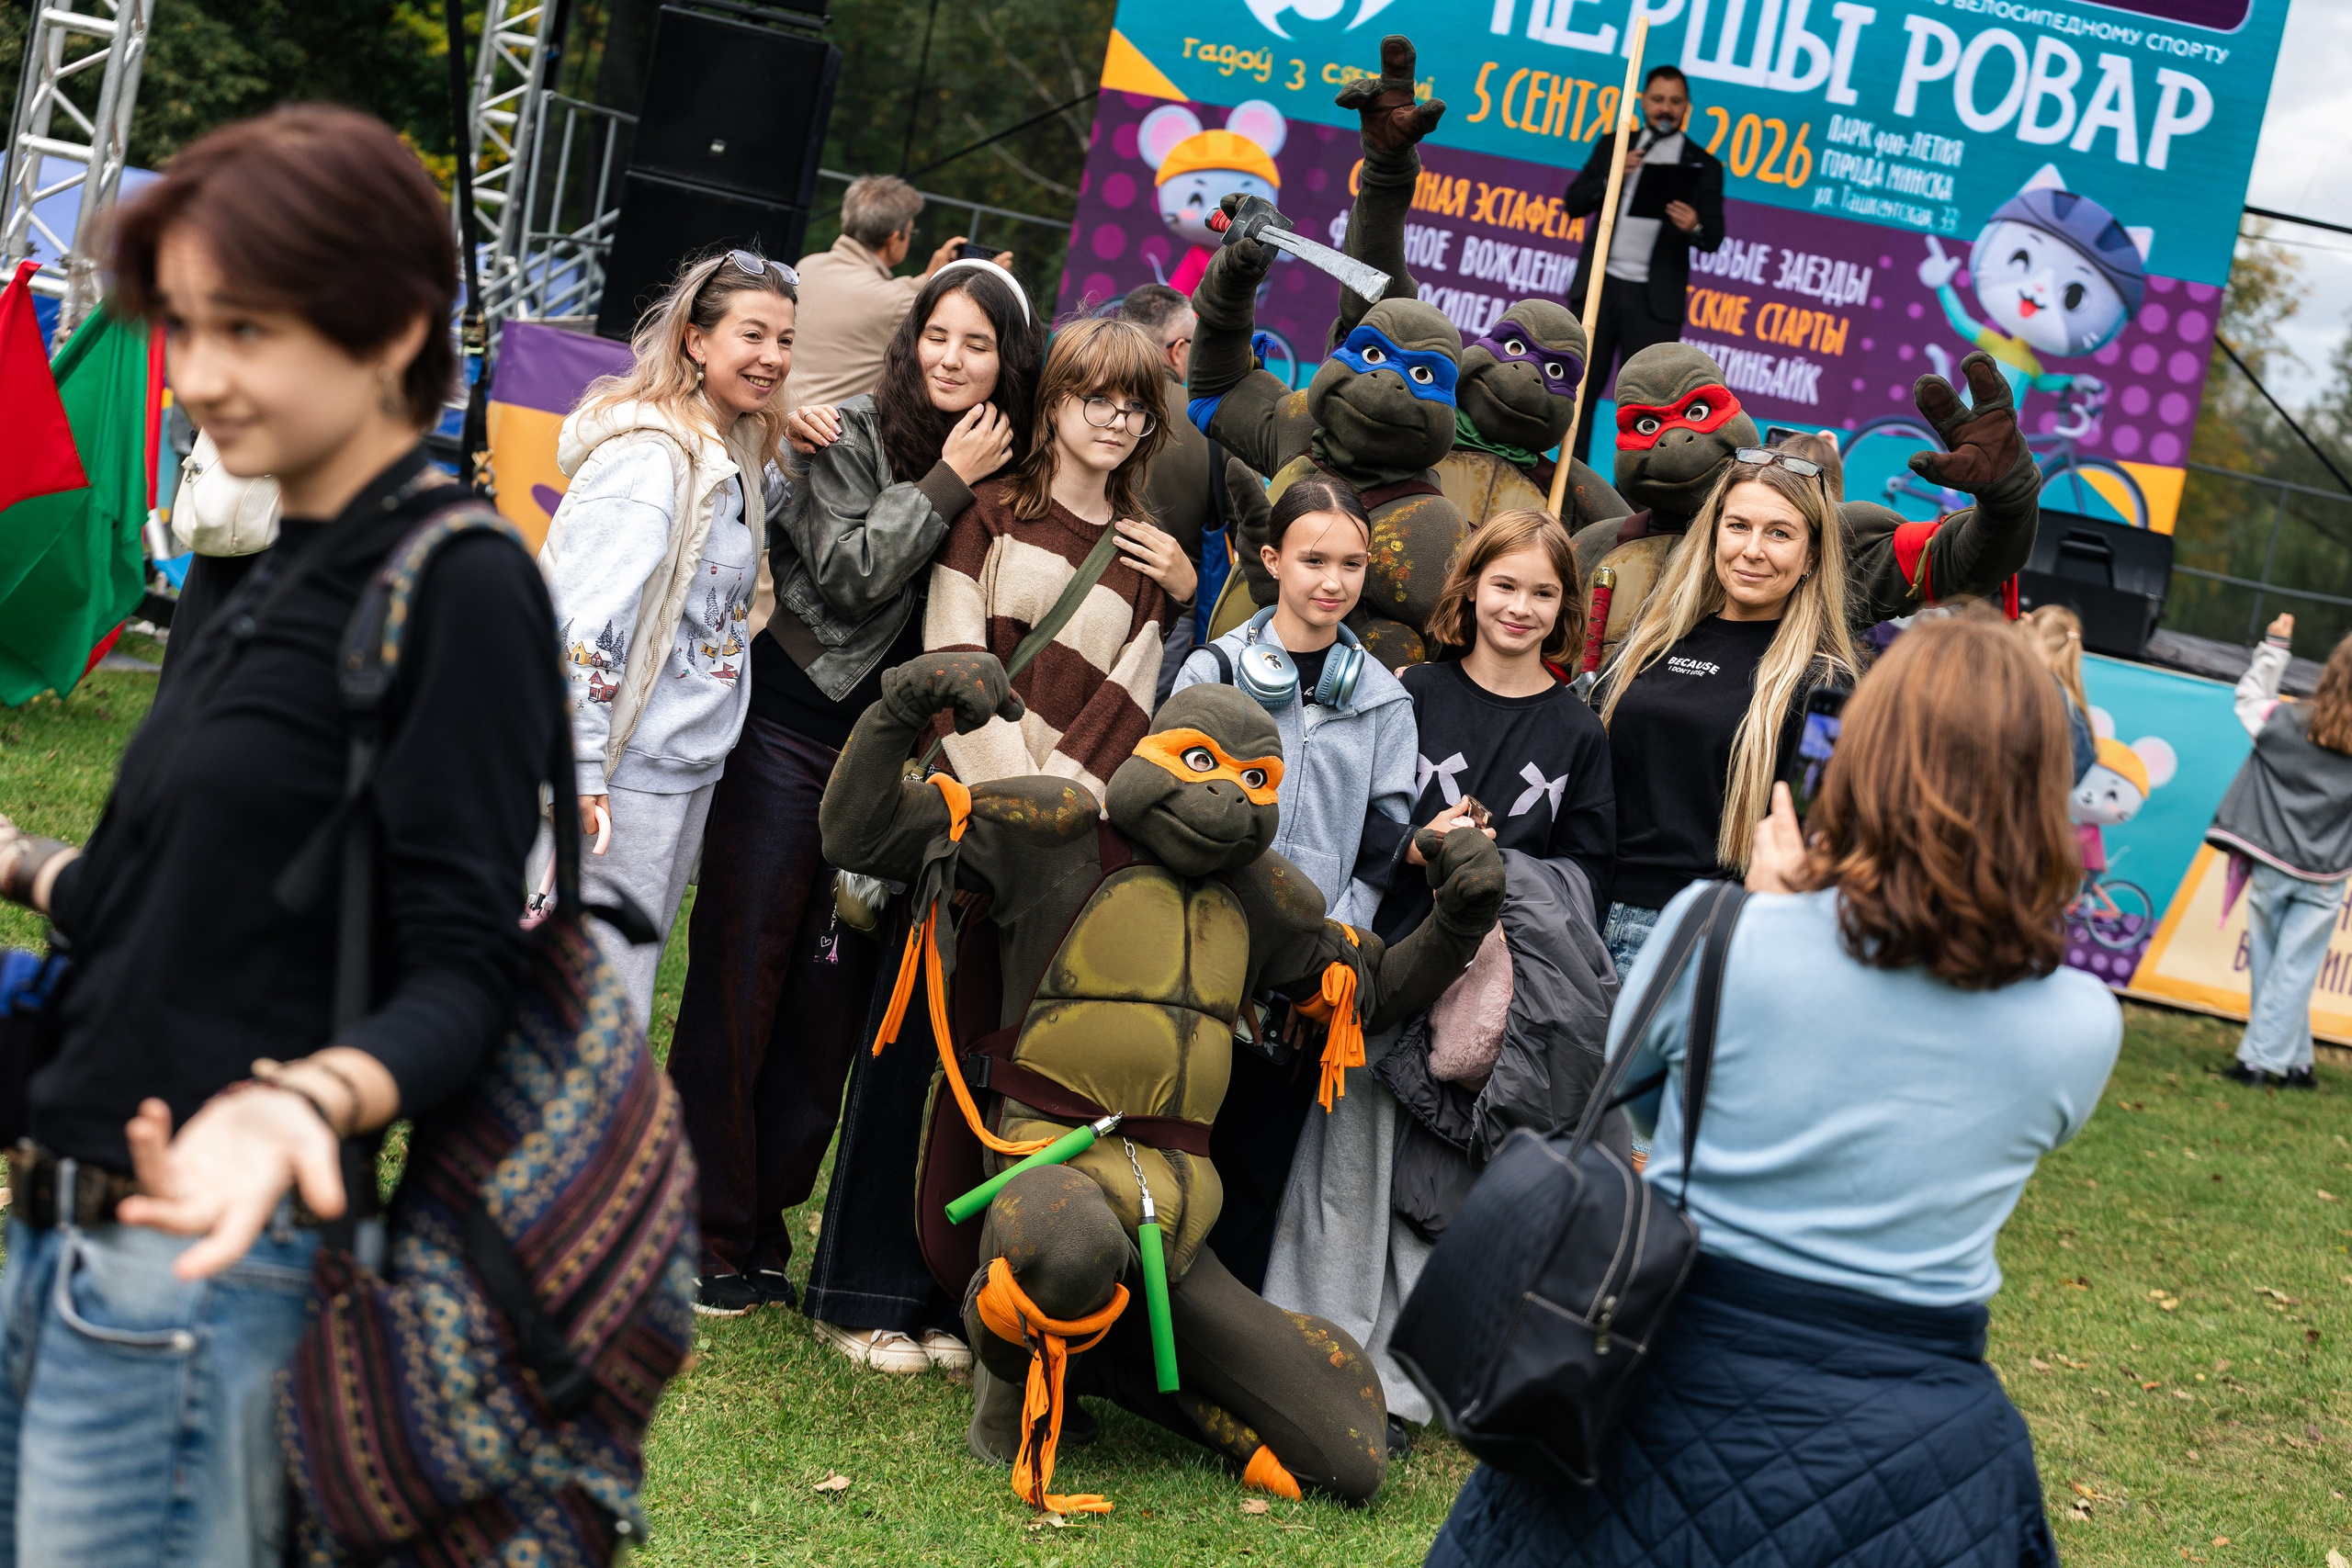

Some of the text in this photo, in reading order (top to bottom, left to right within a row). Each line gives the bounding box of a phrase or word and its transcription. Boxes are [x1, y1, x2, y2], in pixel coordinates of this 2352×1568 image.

[2144, 32, 2231, 65] СПОРТУ
[1893, 14, 2214, 171] РОВАР
[1465, 62, 1813, 189] 5 СЕНТЯ 2026
[1826, 114, 1875, 149] ПАРК
[1820, 149, 1955, 202] ГОРОДА МИНСКА
[1812, 186, 1835, 209] ул.
[1939, 206, 1962, 232] 33
[1458, 234, 1580, 295] ВОЖДЕНИ
[1772, 248, 1873, 308] ЗАЕЗДЫ
[1686, 285, 1850, 357] СКИЕ СТАРТЫ
[1668, 656, 1721, 675] BECAUSE
[1671, 666, 1691, 675] DON'T
